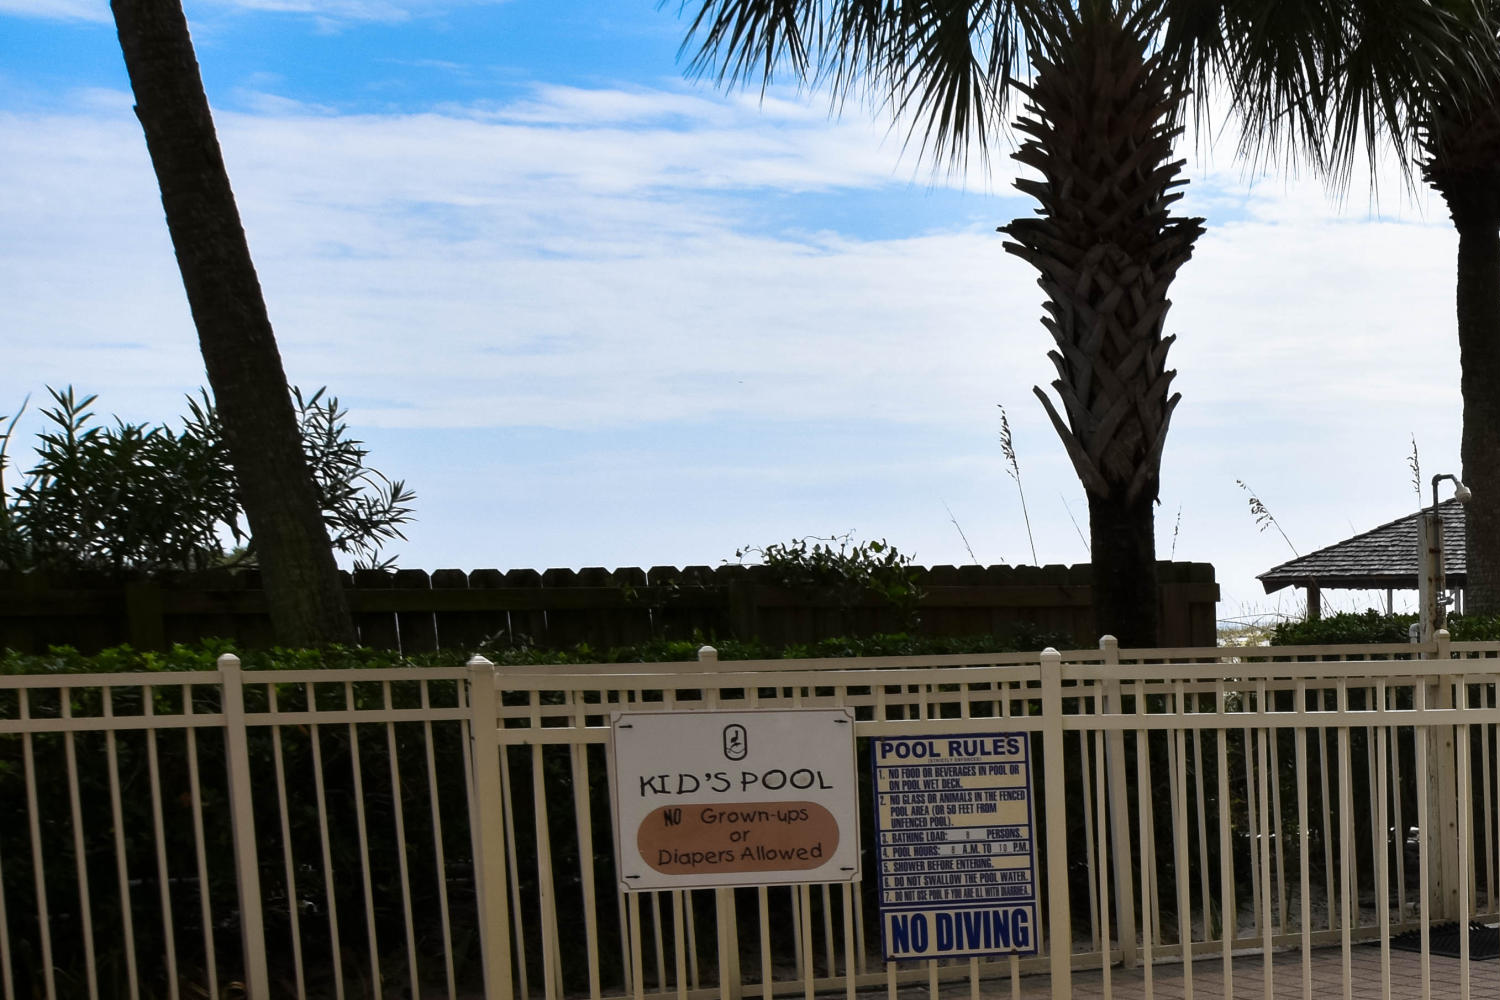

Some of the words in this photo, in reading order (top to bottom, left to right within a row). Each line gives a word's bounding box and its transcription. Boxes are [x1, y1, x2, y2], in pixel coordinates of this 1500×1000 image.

[881, 742, 941, 759] POOL
[948, 738, 1019, 757] RULES
[879, 770, 885, 779] 1.
[889, 768, 899, 779] NO
[902, 768, 920, 778] FOOD
[923, 767, 933, 777] OR
[935, 766, 976, 777] BEVERAGES
[979, 766, 986, 776] IN
[989, 765, 1007, 775] POOL
[1010, 765, 1019, 774] OR
[640, 772, 731, 797] KID'S
[740, 769, 833, 792] POOL
[889, 780, 899, 790] ON
[902, 780, 920, 789] POOL
[923, 779, 939, 789] WET
[942, 778, 963, 788] DECK.
[880, 796, 886, 805] 2.
[890, 794, 899, 805] NO
[902, 794, 925, 804] GLASS
[928, 794, 937, 803] OR
[940, 792, 972, 803] ANIMALS
[975, 792, 982, 801] IN
[984, 791, 997, 801] THE
[999, 790, 1025, 800] FENCED
[664, 808, 681, 827] NO
[701, 808, 809, 827] Grown-ups
[891, 807, 908, 817] POOL
[911, 805, 929, 816] AREA
[932, 804, 945, 816] (OR
[947, 804, 956, 814] 50
[959, 804, 975, 814] FEET
[976, 803, 997, 813] FROM
[891, 818, 927, 828] UNFENCED
[730, 830, 751, 842] or
[892, 832, 924, 843] BATHING
[927, 831, 948, 841] LOAD:
[987, 829, 1022, 839] PERSONS.
[658, 849, 735, 868] Diapers
[740, 843, 823, 862] Allowed
[893, 847, 911, 857] POOL
[914, 846, 940, 856] HOURS:
[963, 844, 981, 854] A.M.
[983, 843, 992, 853] TO
[1013, 842, 1029, 852] P.M.
[894, 861, 925, 872] SHOWER
[928, 860, 954, 871] BEFORE
[956, 858, 994, 869] ENTERING.
[895, 877, 904, 887] DO
[907, 876, 921, 886] NOT
[924, 874, 961, 885] SWALLOW
[965, 874, 977, 884] THE
[980, 873, 998, 883] POOL
[1001, 872, 1028, 882] WATER.
[891, 913, 928, 953] NO
[935, 908, 1029, 951] DIVING
